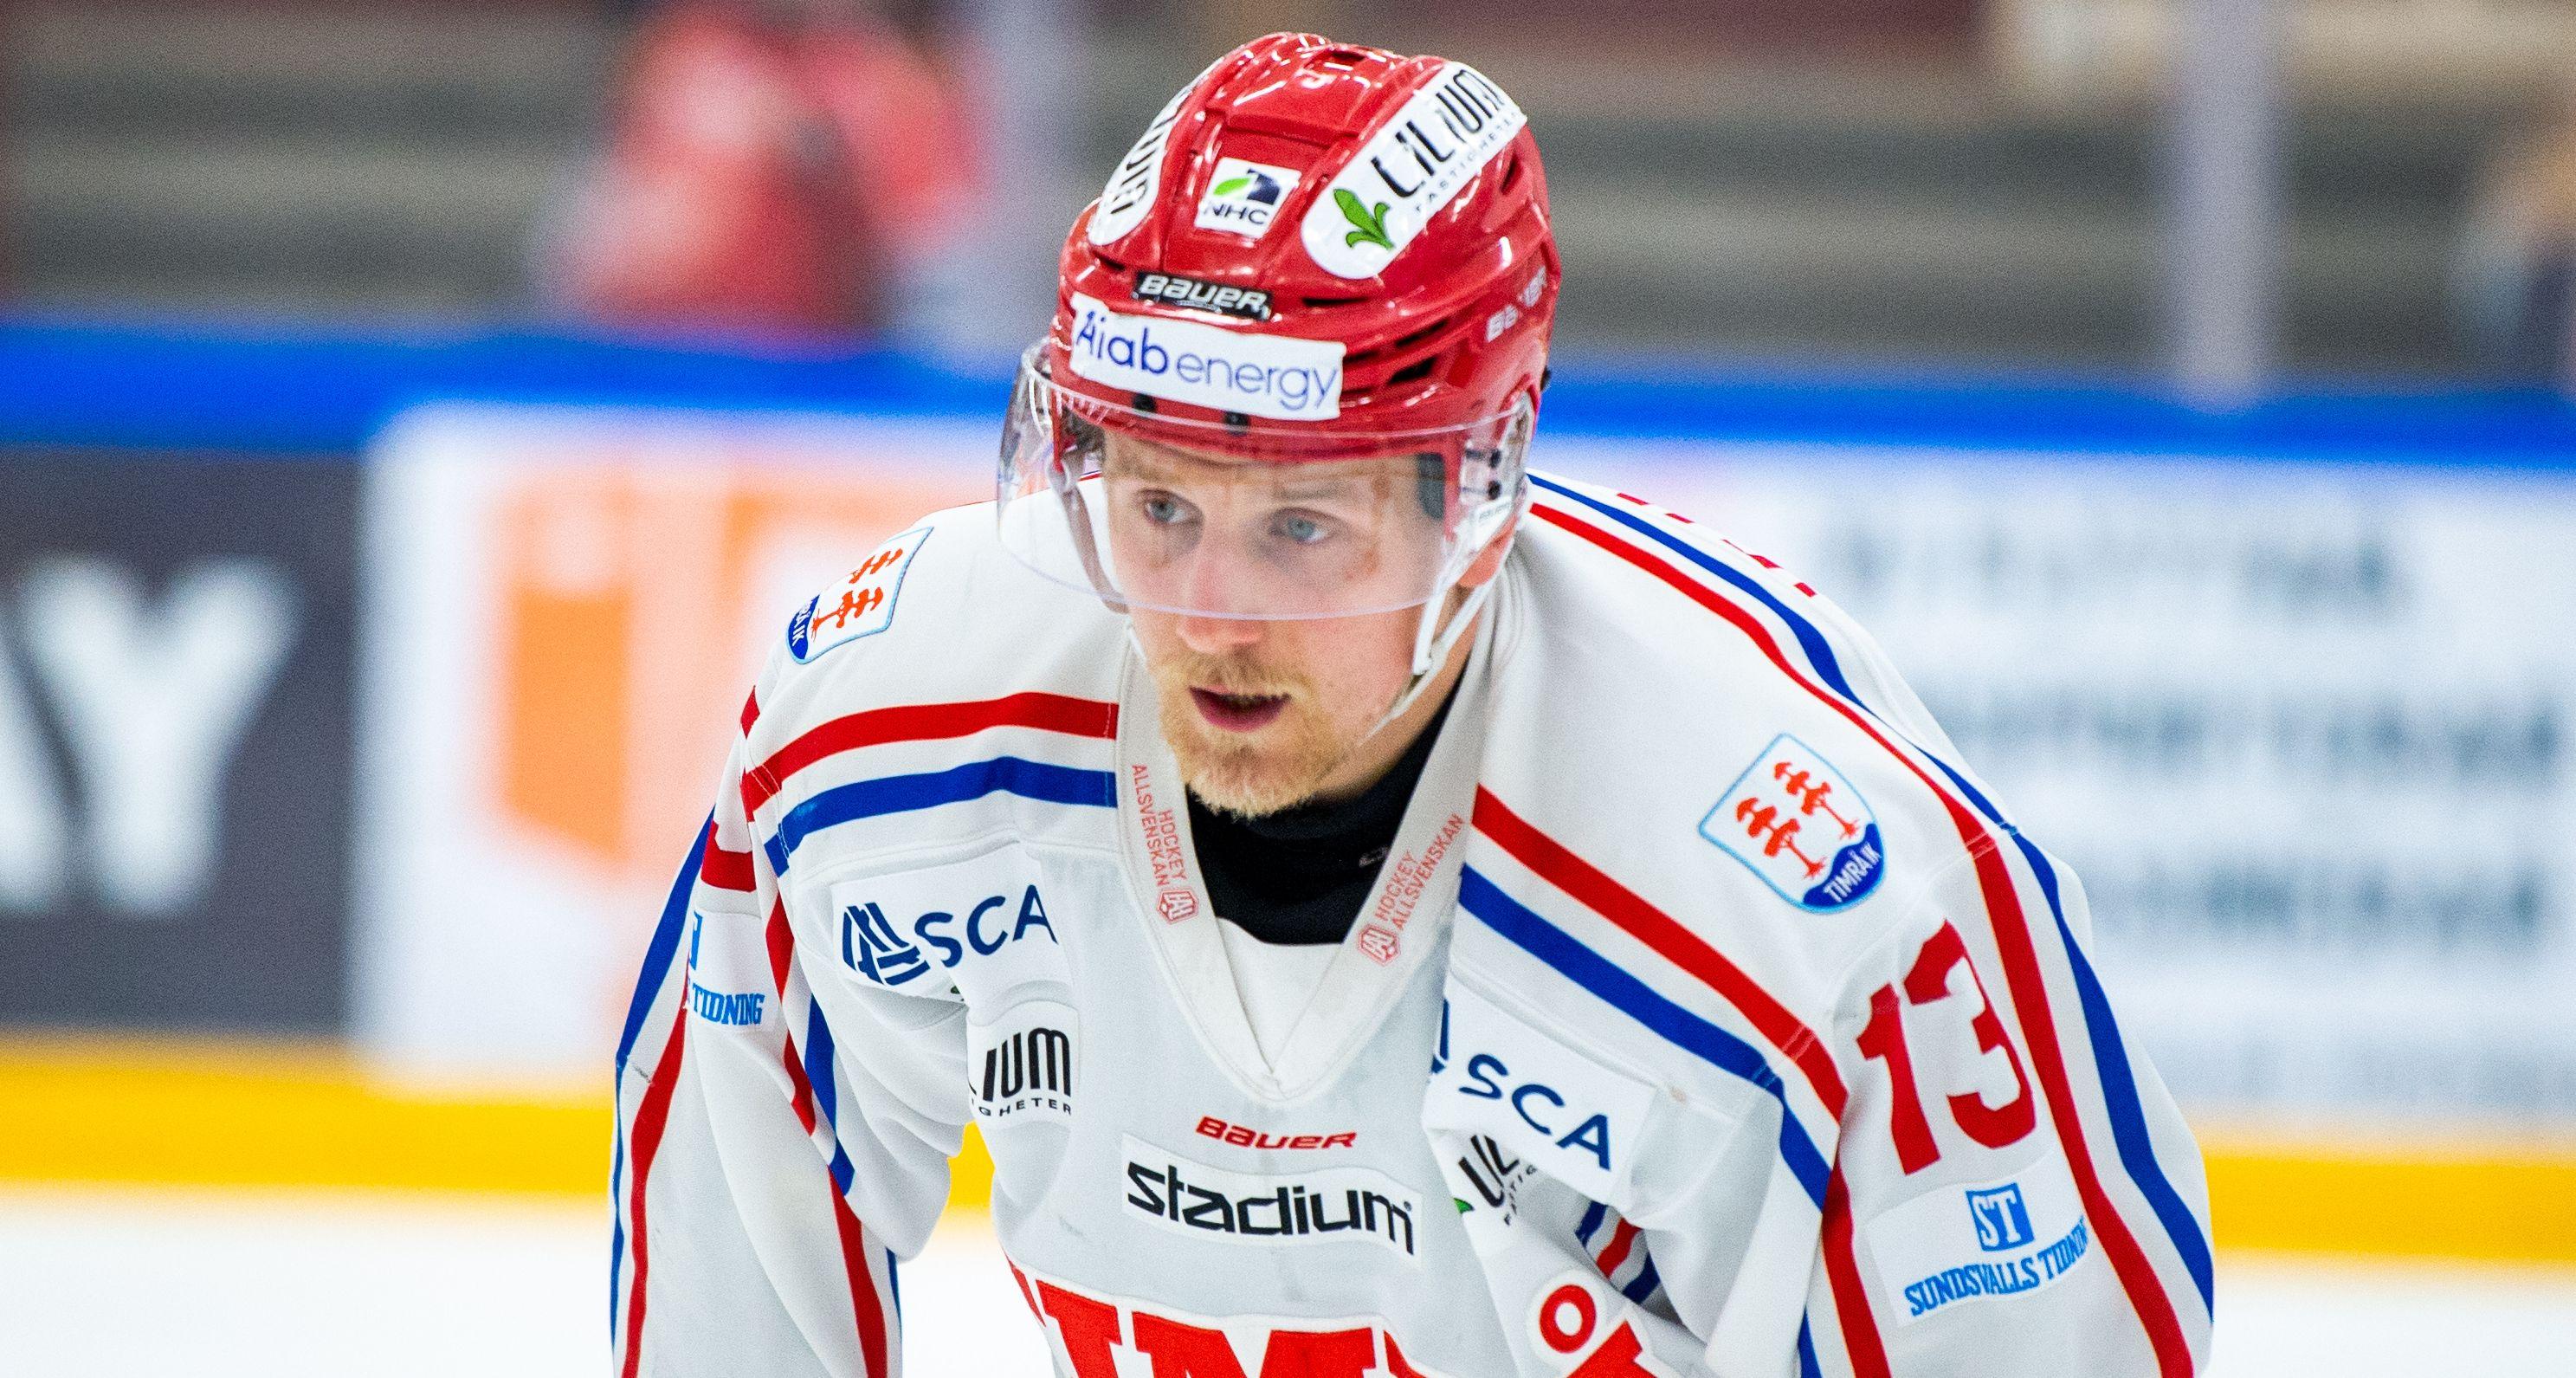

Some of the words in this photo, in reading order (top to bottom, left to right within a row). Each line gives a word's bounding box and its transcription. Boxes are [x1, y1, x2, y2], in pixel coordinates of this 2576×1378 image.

[1203, 200, 1269, 225] NHC
[1132, 764, 1170, 887] ALLSVENSKAN
[1158, 808, 1188, 881] HOCKEY
[1374, 848, 1418, 922] HOCKEY
[1391, 812, 1465, 932] ALLSVENSKAN
[914, 884, 1059, 969] SCA
[692, 981, 765, 1026] TIDNING
[1856, 919, 2037, 1176] 13
[1458, 1053, 1612, 1173] SCA
[1972, 1189, 2018, 1248] ST
[1904, 1257, 2041, 1317] SUNDSVALLS
